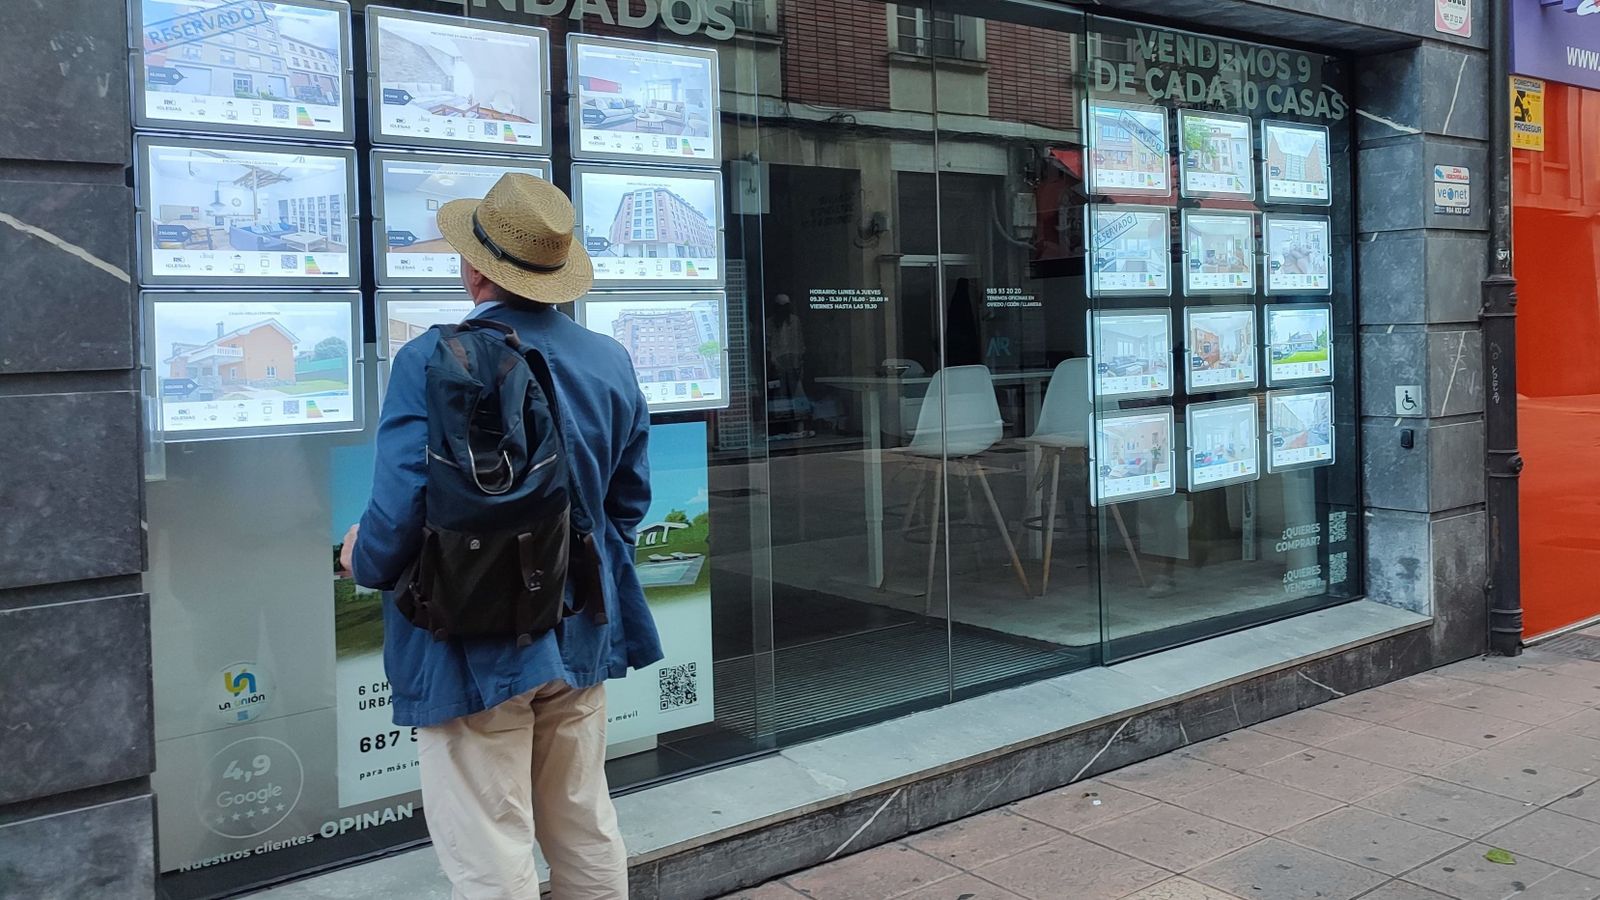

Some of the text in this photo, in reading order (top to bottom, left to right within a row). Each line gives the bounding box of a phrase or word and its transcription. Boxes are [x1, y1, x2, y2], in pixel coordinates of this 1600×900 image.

[149, 7, 256, 45] RESERVADO
[1136, 28, 1311, 83] VENDEMOS 9
[1094, 59, 1345, 120] DE CADA 10 CASAS
[1514, 122, 1542, 134] PROSEGUR
[1282, 523, 1320, 540] ¿QUIERES
[1275, 536, 1320, 552] COMPRAR?
[1282, 565, 1321, 583] ¿QUIERES
[358, 686, 366, 695] 6
[615, 709, 638, 721] móvil
[359, 730, 401, 753] 687
[222, 754, 272, 783] 4,9
[359, 769, 383, 780] para
[386, 762, 407, 773] más
[216, 783, 282, 808] Google
[179, 802, 414, 873] Nuestros clientes OPINAN
